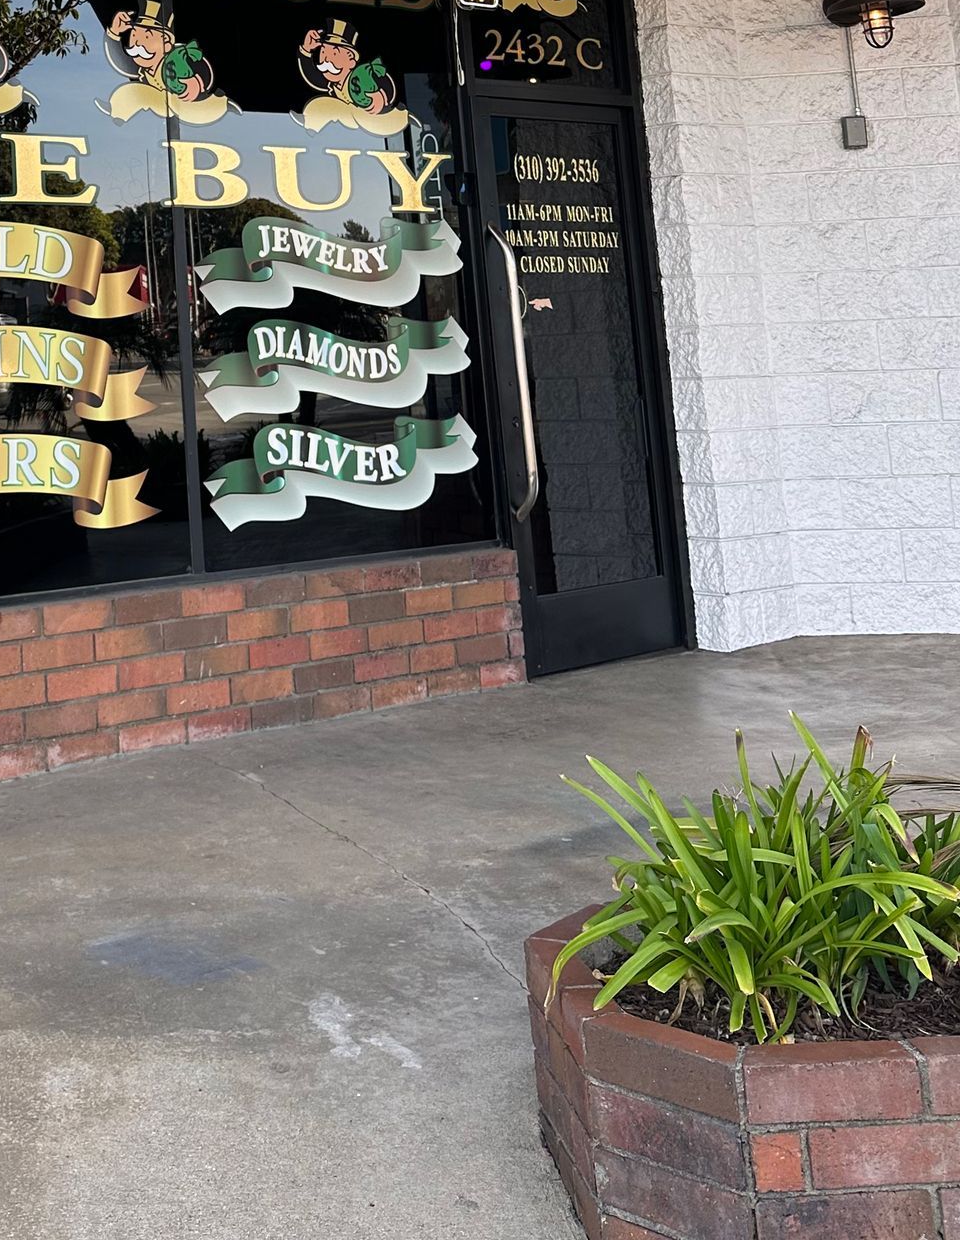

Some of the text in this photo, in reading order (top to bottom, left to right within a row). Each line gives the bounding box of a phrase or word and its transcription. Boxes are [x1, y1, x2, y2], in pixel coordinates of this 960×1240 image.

[485, 29, 603, 70] 2432 C
[162, 140, 451, 214] BUY
[514, 153, 599, 184] (310) 392-3536
[506, 203, 614, 223] 11AM-6PM MON-FRI
[258, 225, 388, 275] JEWELRY
[563, 230, 619, 249] SATURDAY
[520, 255, 610, 274] CLOSED SUNDAY
[256, 325, 403, 380] DIAMONDS
[266, 428, 406, 483] SILVER
